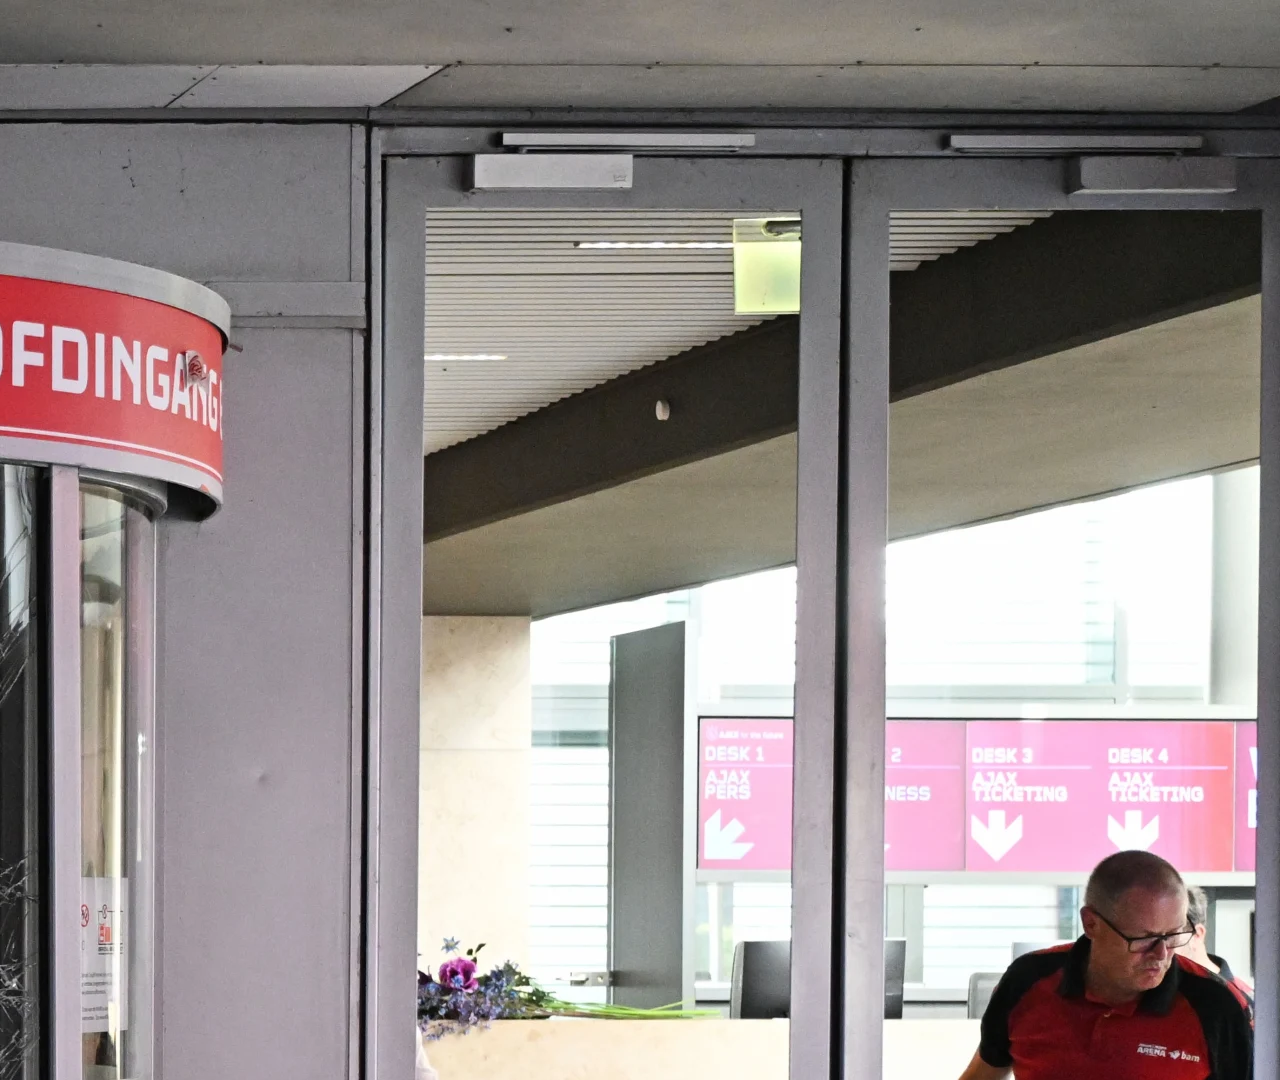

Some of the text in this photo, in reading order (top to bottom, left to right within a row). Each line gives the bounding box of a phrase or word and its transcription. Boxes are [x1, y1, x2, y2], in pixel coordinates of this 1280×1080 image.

[704, 745, 765, 762] DESK 1
[890, 747, 902, 763] 2
[971, 747, 1033, 764] DESK 3
[1107, 747, 1169, 764] DESK 4
[705, 769, 751, 785] AJAX
[972, 771, 1017, 787] AJAX
[1109, 771, 1154, 787] AJAX
[704, 783, 751, 800] PERS
[885, 785, 931, 802] NESS
[973, 785, 1068, 802] TICKETING
[1109, 786, 1204, 802] TICKETING
[1137, 1047, 1166, 1057] ARENA
[1181, 1051, 1200, 1062] bam
